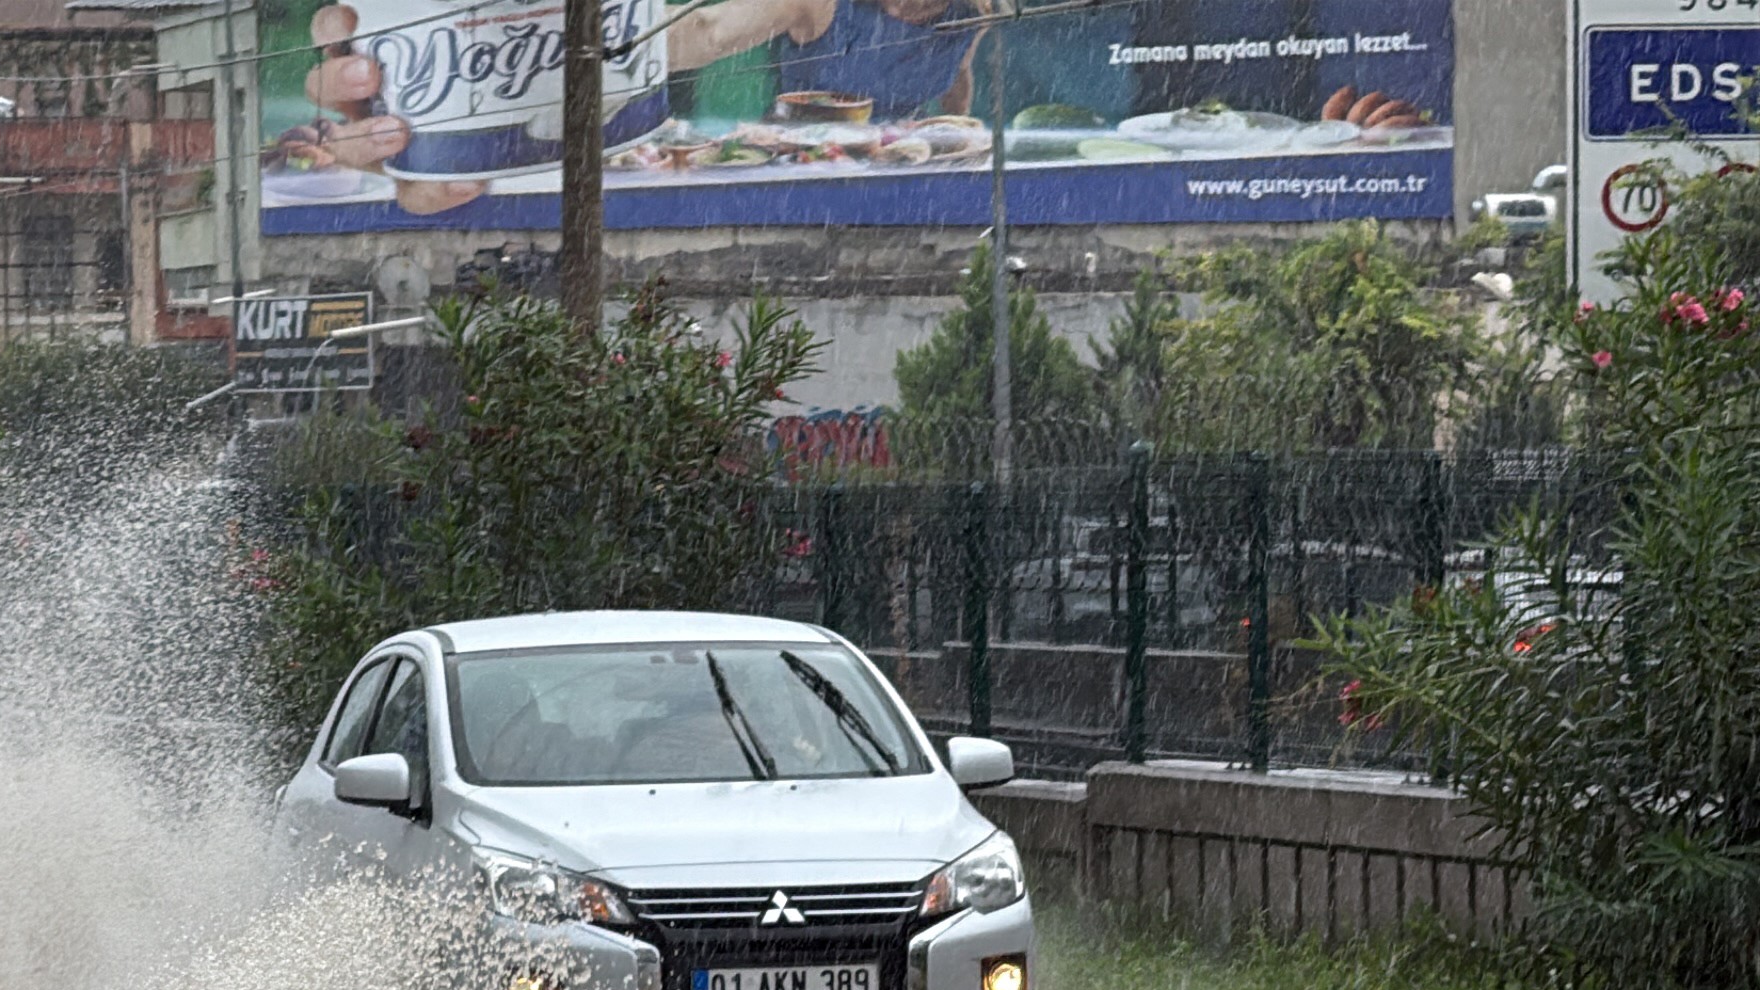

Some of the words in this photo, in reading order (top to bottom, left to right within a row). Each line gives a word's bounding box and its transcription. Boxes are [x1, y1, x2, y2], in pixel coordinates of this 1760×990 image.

[1108, 43, 1188, 65] Zamana
[1193, 37, 1271, 64] meydan
[1276, 35, 1348, 59] okuyan
[1354, 31, 1428, 53] lezzet...
[1187, 174, 1427, 199] www.guneysut.com.tr
[236, 299, 309, 340] KURT
